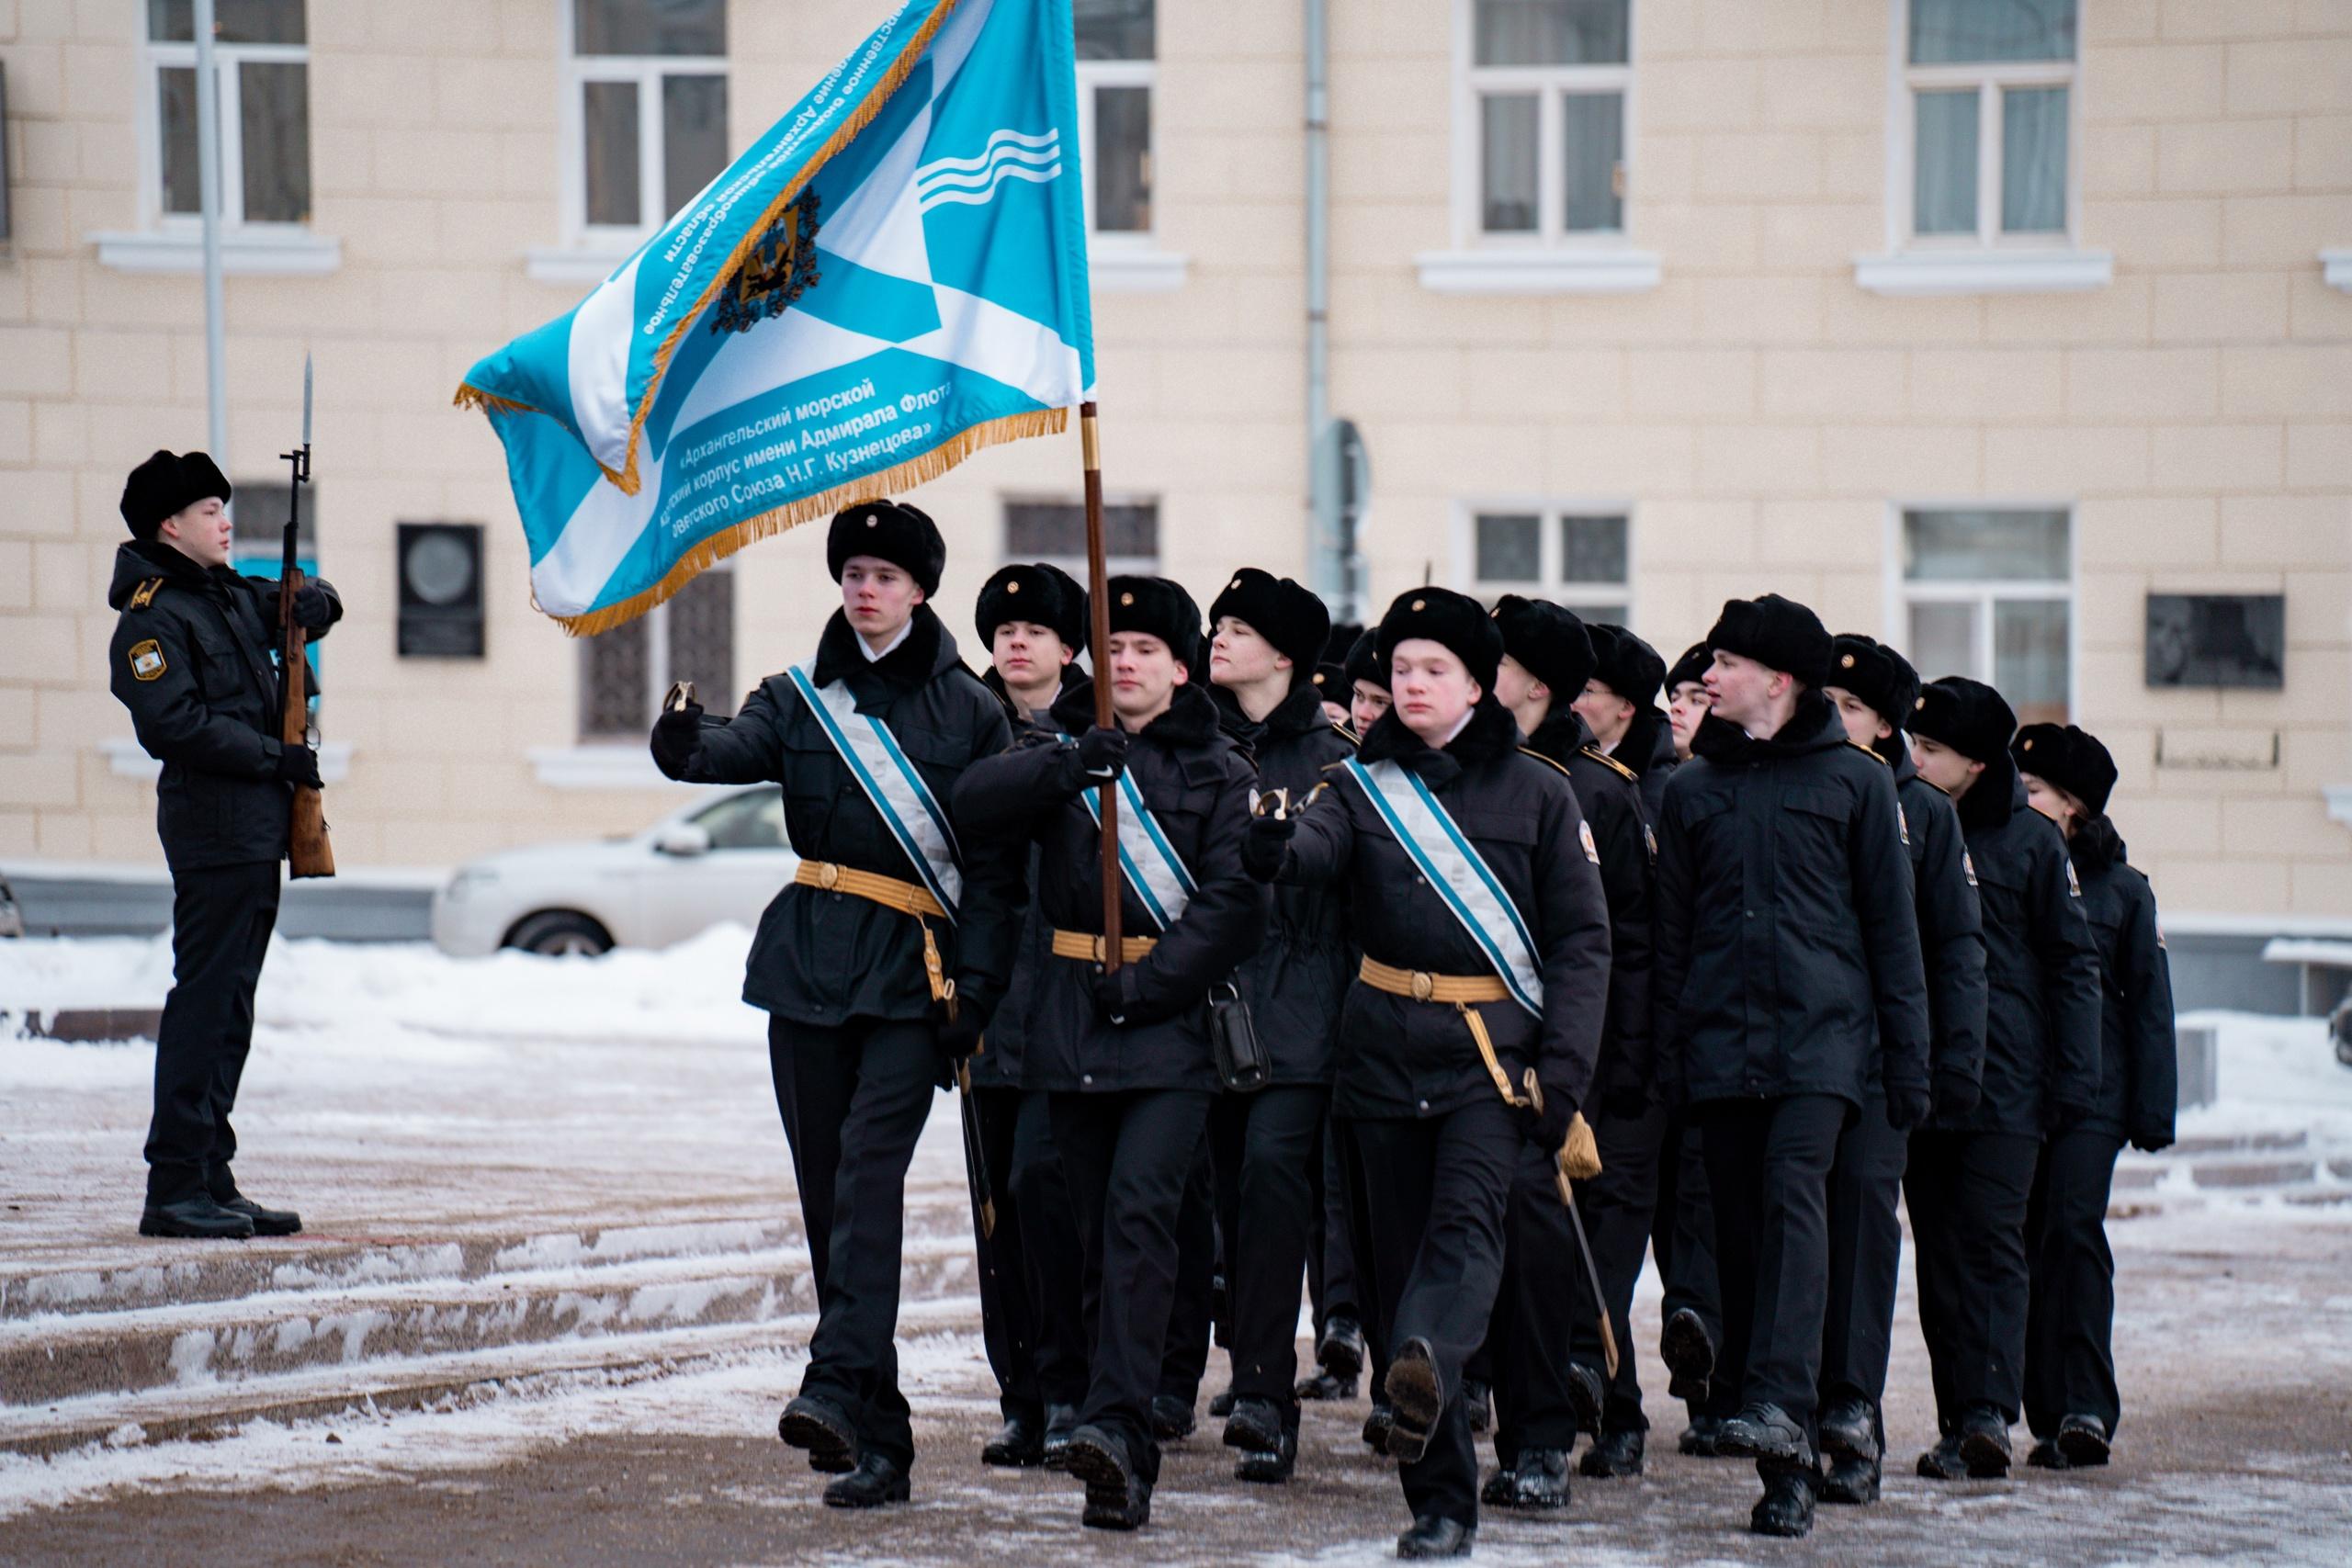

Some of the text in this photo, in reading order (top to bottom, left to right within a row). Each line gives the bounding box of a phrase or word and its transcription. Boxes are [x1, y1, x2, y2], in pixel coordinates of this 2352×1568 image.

[663, 203, 715, 263] области
[680, 378, 876, 469] «Архангельский морской
[694, 459, 741, 493] корпус
[743, 439, 797, 469] имени
[801, 404, 899, 450] Адмирала
[731, 473, 786, 503] Союза
[825, 423, 932, 472] Кузнецова»
